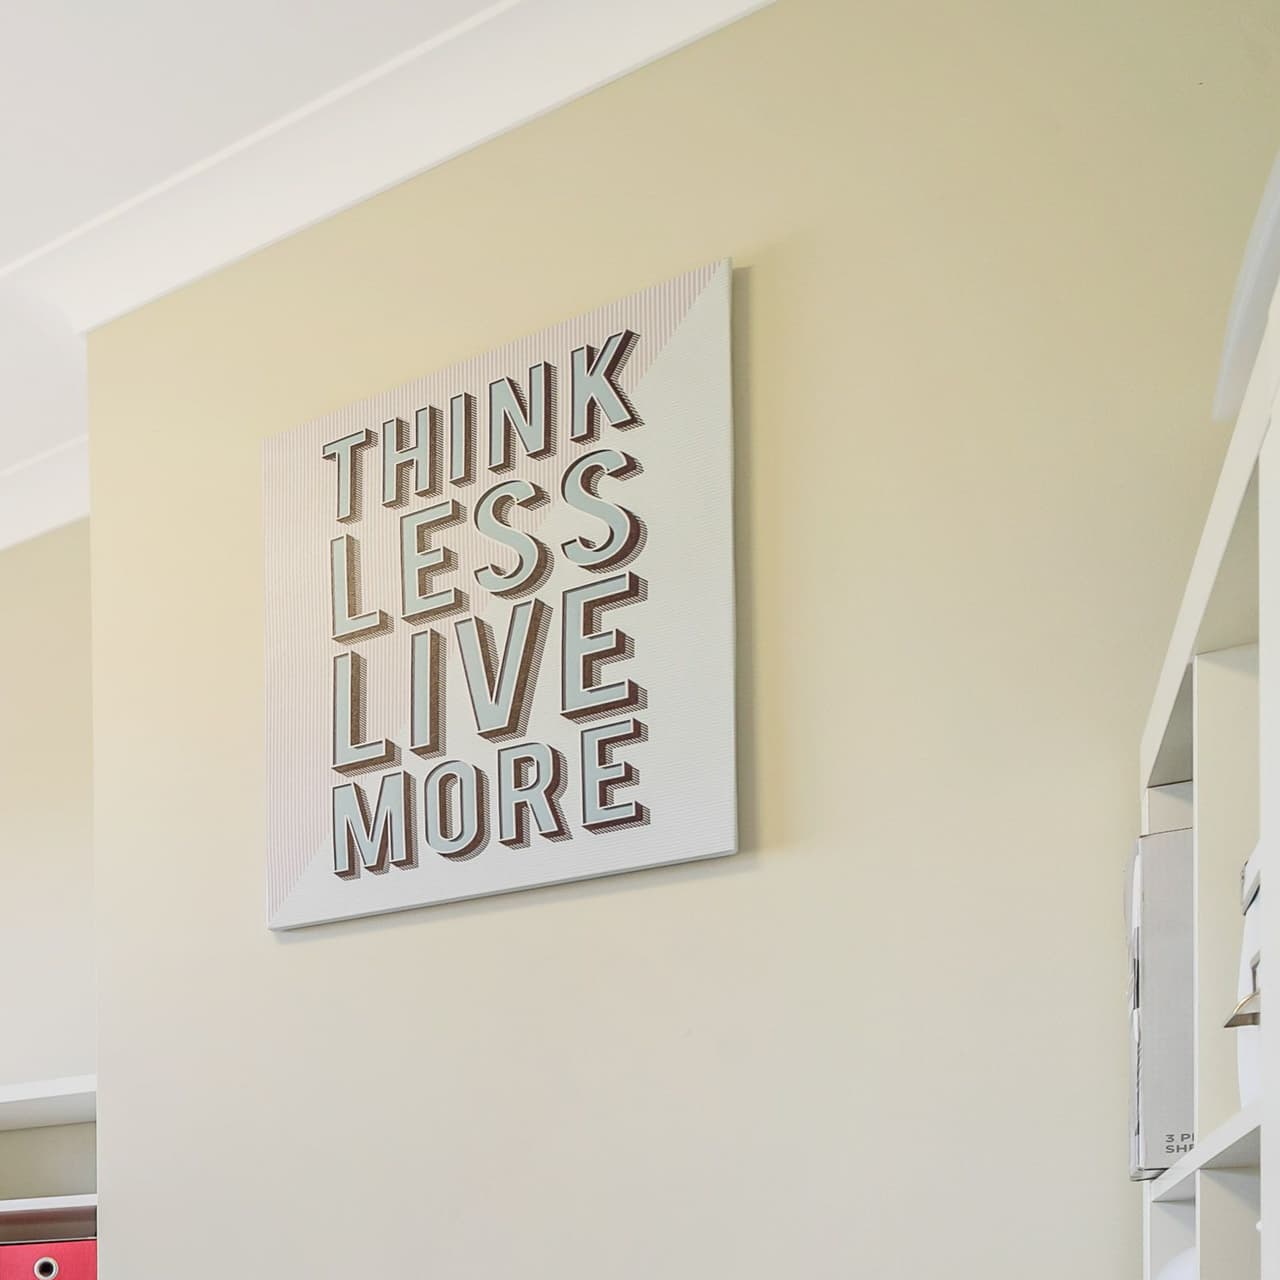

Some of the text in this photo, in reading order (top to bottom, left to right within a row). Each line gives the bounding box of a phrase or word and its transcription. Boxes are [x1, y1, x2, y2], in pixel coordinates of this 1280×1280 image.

[322, 328, 645, 523] THINK
[330, 447, 648, 643] LESS
[331, 571, 648, 774] LIVE
[332, 718, 650, 880] MORE
[1165, 1134, 1175, 1143] 3
